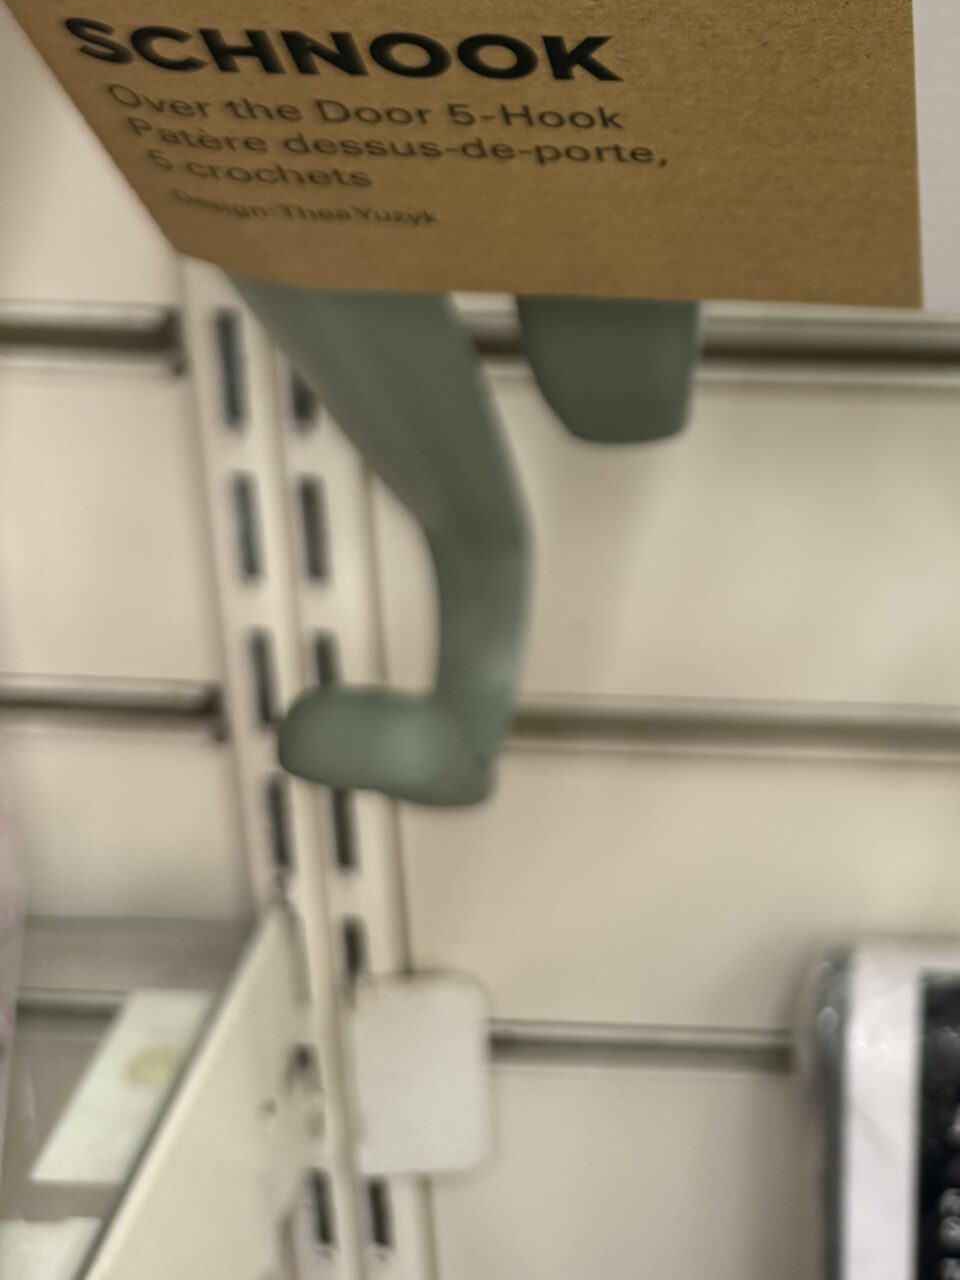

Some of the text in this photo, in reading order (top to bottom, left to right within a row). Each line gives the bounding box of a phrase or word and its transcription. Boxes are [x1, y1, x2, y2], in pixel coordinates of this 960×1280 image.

[62, 16, 626, 83] SCHNOOK
[106, 83, 624, 131] Over the Door 5-Hook
[126, 114, 669, 168] Patère dessus-de-porte,
[146, 147, 373, 188] 5 crochets
